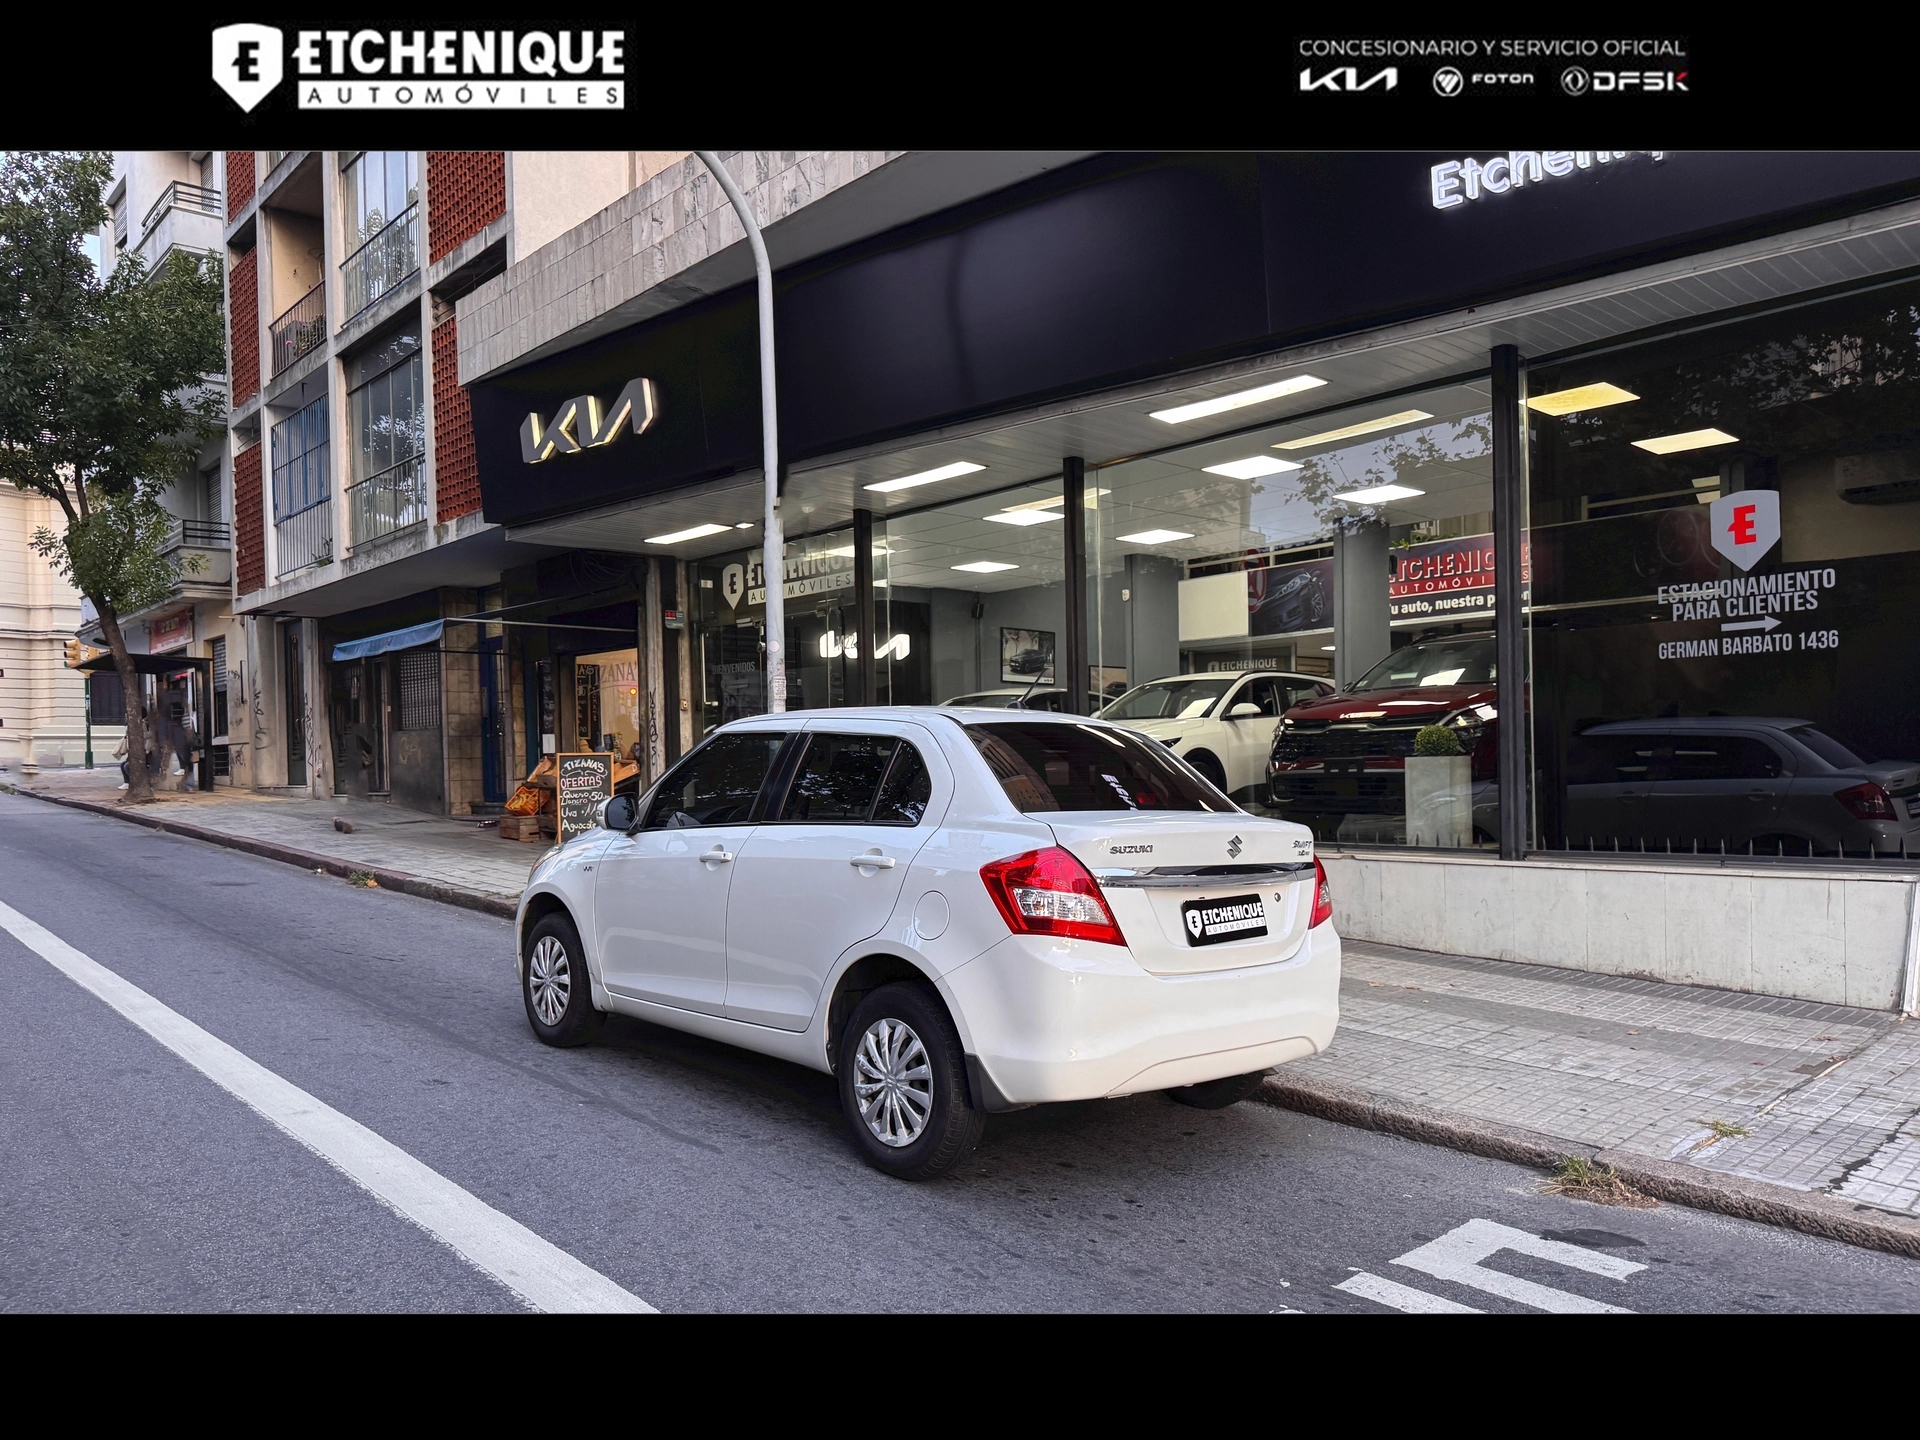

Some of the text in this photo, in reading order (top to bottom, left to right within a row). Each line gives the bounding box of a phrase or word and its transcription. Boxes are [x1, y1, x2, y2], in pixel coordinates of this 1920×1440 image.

[519, 378, 657, 464] KIA
[750, 573, 851, 603] AUMÓVILES
[1657, 568, 1836, 605] ESTACIONAMIENTO
[1400, 601, 1433, 614] auto,
[1435, 593, 1484, 610] nuestra
[1672, 590, 1819, 622] PARA CLIENTES
[1658, 630, 1839, 660] GERMAN BARBATO 1436
[1221, 658, 1277, 671] ETCHENIQUE
[560, 775, 603, 789] OFERTAS
[1110, 845, 1153, 854] SUZUKI
[1202, 902, 1263, 924] ETCHENIQUE
